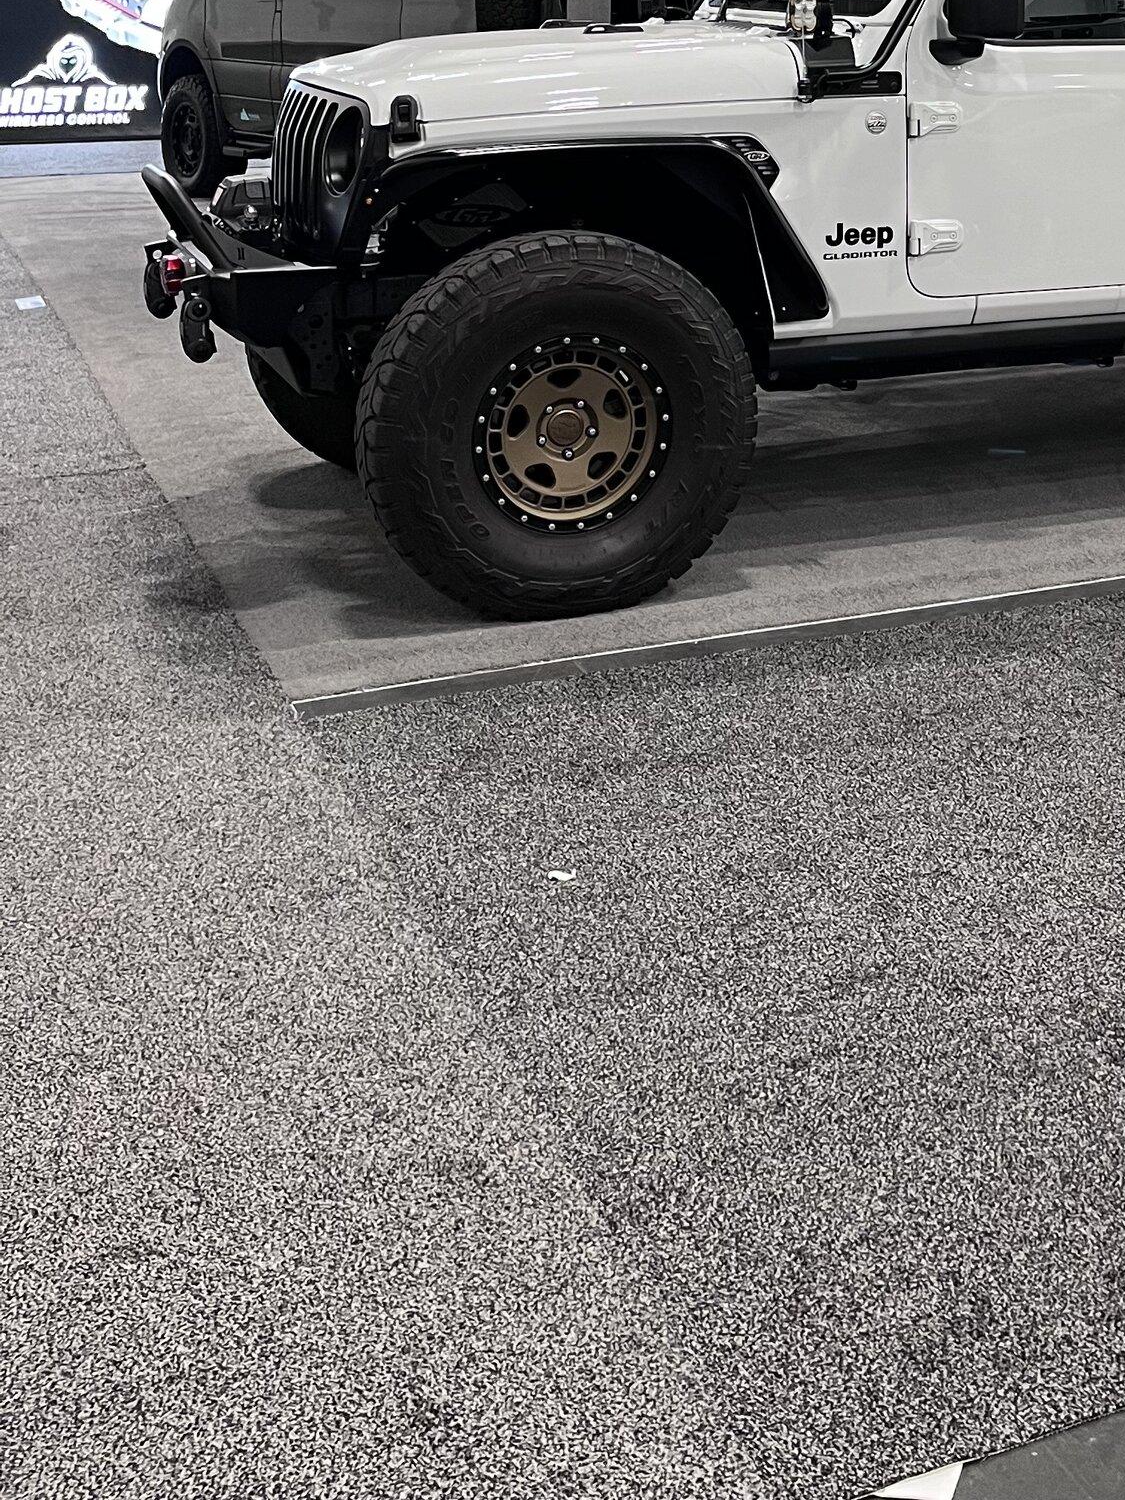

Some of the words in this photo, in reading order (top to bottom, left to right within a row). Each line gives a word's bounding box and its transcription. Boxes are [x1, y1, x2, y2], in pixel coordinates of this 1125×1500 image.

[0, 85, 82, 114] HOST
[83, 84, 149, 112] BOX
[66, 112, 130, 126] CONTROL
[825, 222, 894, 249] Jeep
[822, 249, 898, 261] GLADIATOR
